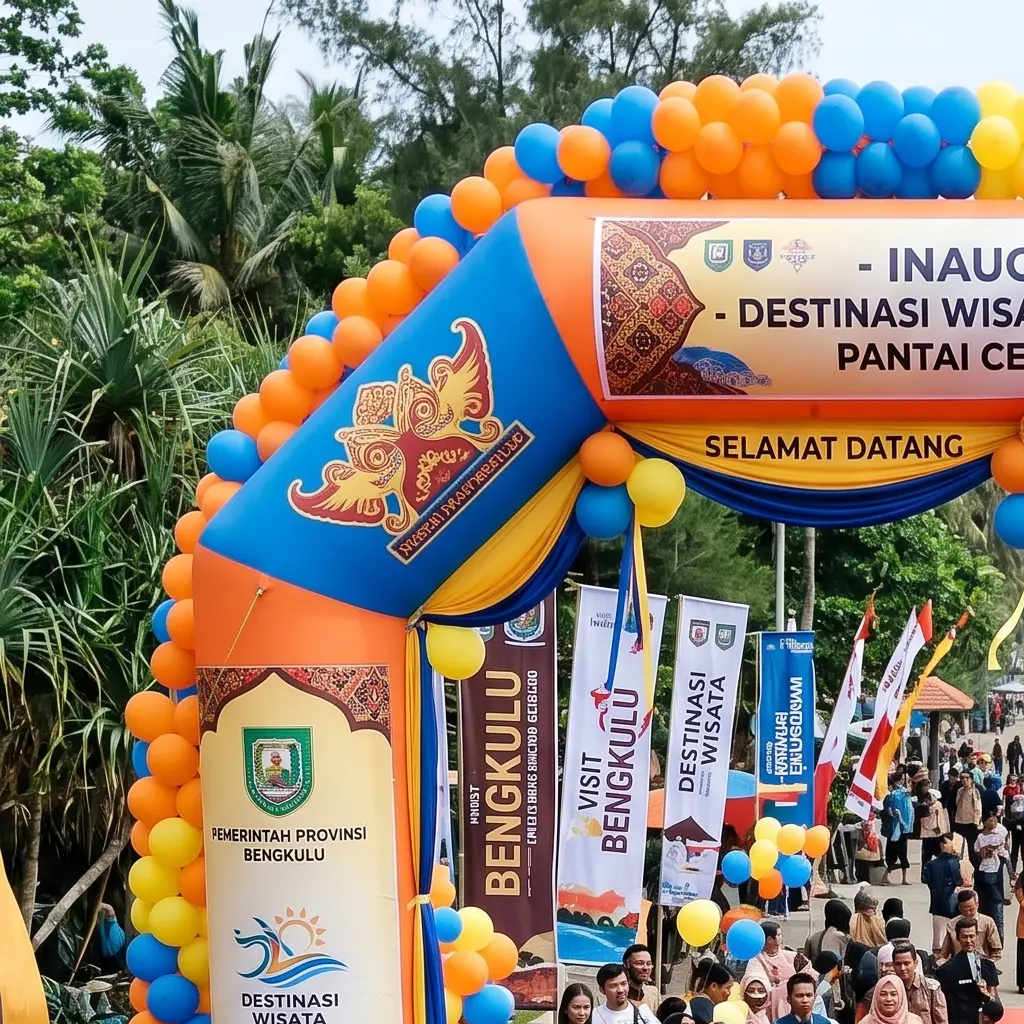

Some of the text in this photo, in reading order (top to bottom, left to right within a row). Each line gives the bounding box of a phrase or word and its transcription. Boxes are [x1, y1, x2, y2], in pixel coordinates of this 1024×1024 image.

[739, 298, 929, 328] DESTINASI
[838, 342, 968, 371] PANTAI
[705, 434, 964, 461] SELAMAT DATANG
[678, 671, 706, 793] DESTINASI
[700, 675, 726, 766] WISATA
[484, 669, 522, 898] BENGKULU
[578, 752, 602, 811] VISIT
[601, 687, 639, 854] BENGKULU
[212, 826, 367, 843] PEMERINTAH PROVINSI
[244, 848, 325, 862] BENGKULU
[242, 993, 339, 1008] DESTINASI
